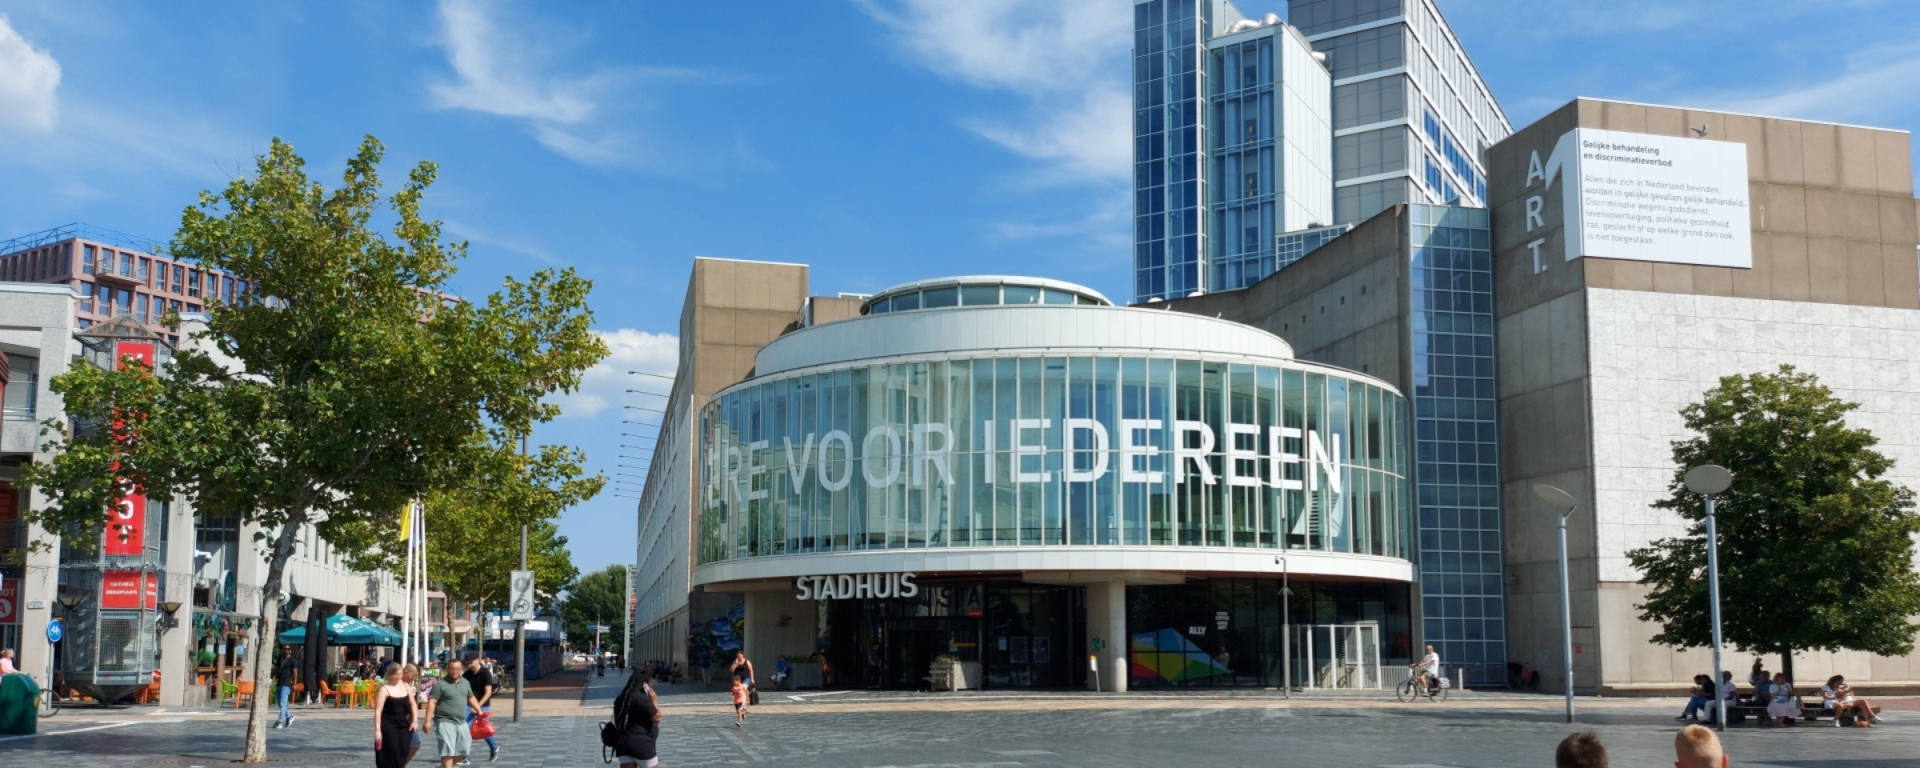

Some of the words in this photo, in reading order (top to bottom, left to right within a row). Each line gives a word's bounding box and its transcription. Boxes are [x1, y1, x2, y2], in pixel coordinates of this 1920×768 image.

[1583, 140, 1610, 151] Gelijke
[1612, 143, 1659, 156] behandeling
[1595, 153, 1672, 167] discriminatieverbod
[1585, 175, 1604, 183] Allen
[1605, 177, 1617, 185] die
[1620, 178, 1634, 187] zich
[1645, 180, 1684, 191] Nederland
[1585, 187, 1612, 196] worden
[1614, 188, 1621, 196] in
[1624, 190, 1648, 200] gelijke
[1651, 192, 1681, 202] gevallen
[1683, 195, 1703, 205] gelijk
[1585, 197, 1636, 209] Discriminatie
[1638, 202, 1666, 213] wegens
[1656, 215, 1687, 225] politieke
[1586, 232, 1594, 240] is
[1596, 233, 1610, 241] niet
[1612, 234, 1656, 244] toegestaan.
[1603, 223, 1635, 232] geslacht
[1646, 226, 1655, 234] op
[1658, 227, 1679, 235] welke
[1681, 229, 1703, 238] grond
[1704, 230, 1718, 238] dan
[783, 423, 956, 495] VOOR
[984, 418, 1341, 493] IEDEREEN
[796, 572, 919, 600] STADHUIS
[1189, 626, 1207, 635] ALLY
